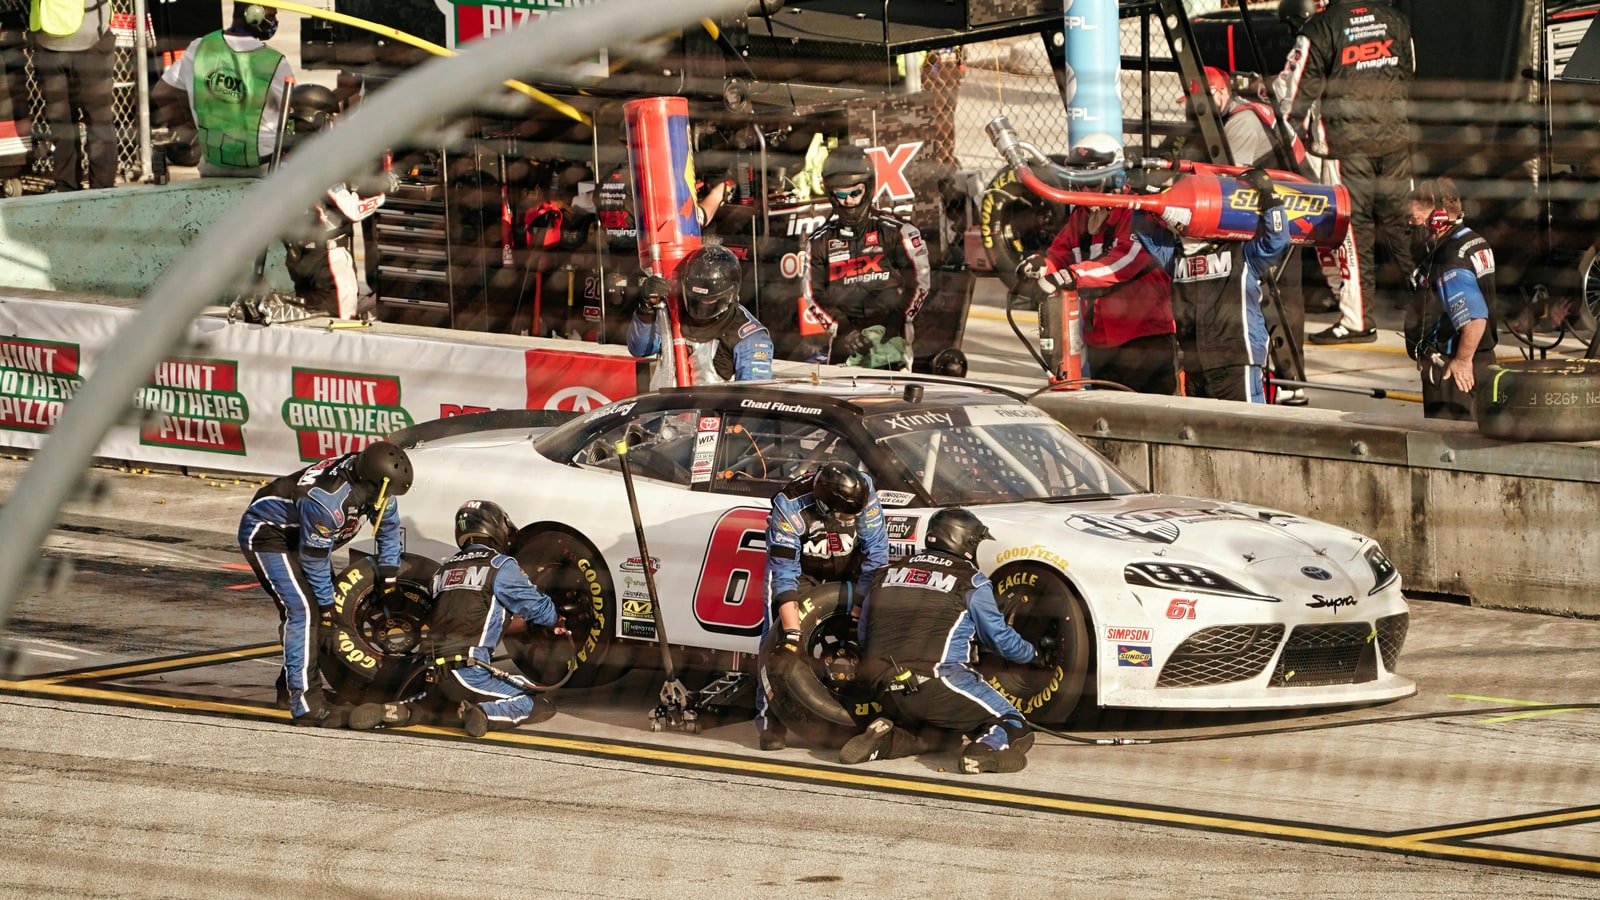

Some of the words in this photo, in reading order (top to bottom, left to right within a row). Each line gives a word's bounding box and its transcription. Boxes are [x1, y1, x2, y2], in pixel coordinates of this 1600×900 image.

[1341, 39, 1394, 65] DEX
[215, 73, 243, 93] FOX
[1233, 191, 1326, 214] SUOCO
[828, 254, 885, 282] DEX
[0, 344, 57, 374] HUNT
[0, 370, 83, 400] OTHERS
[155, 361, 216, 391] HUNT
[134, 387, 244, 420] BROTHERS
[313, 376, 378, 406] HUNT
[0, 396, 64, 426] PIZZA
[289, 402, 407, 434] BROTHERS
[740, 399, 771, 410] Chad
[771, 402, 822, 415] Finchum
[161, 416, 225, 445] PIZZA
[884, 411, 954, 431] xfinity
[699, 434, 715, 445] WIX
[887, 522, 911, 536] finity
[995, 544, 1070, 570] GOODYEAR
[997, 572, 1039, 596] EAGLE
[1305, 595, 1358, 615] Supra
[1107, 628, 1150, 641] SIMPSON
[1120, 653, 1150, 662] SUNOCO
